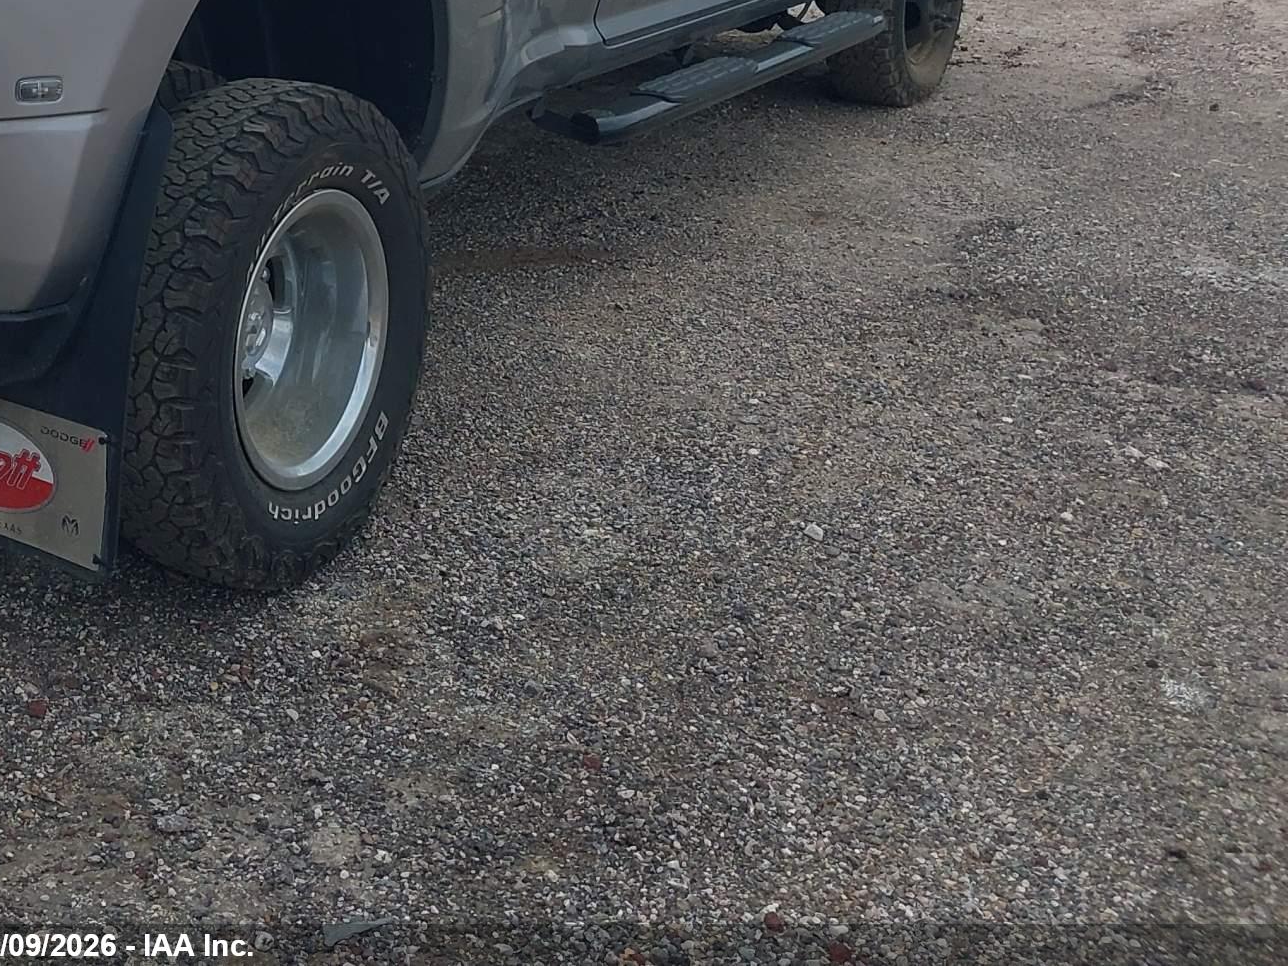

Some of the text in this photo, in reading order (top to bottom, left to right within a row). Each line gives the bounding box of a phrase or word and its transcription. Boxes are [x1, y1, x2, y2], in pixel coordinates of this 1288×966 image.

[360, 169, 391, 205] T/A
[40, 425, 88, 449] DODGE
[268, 410, 389, 525] BFGoodrich
